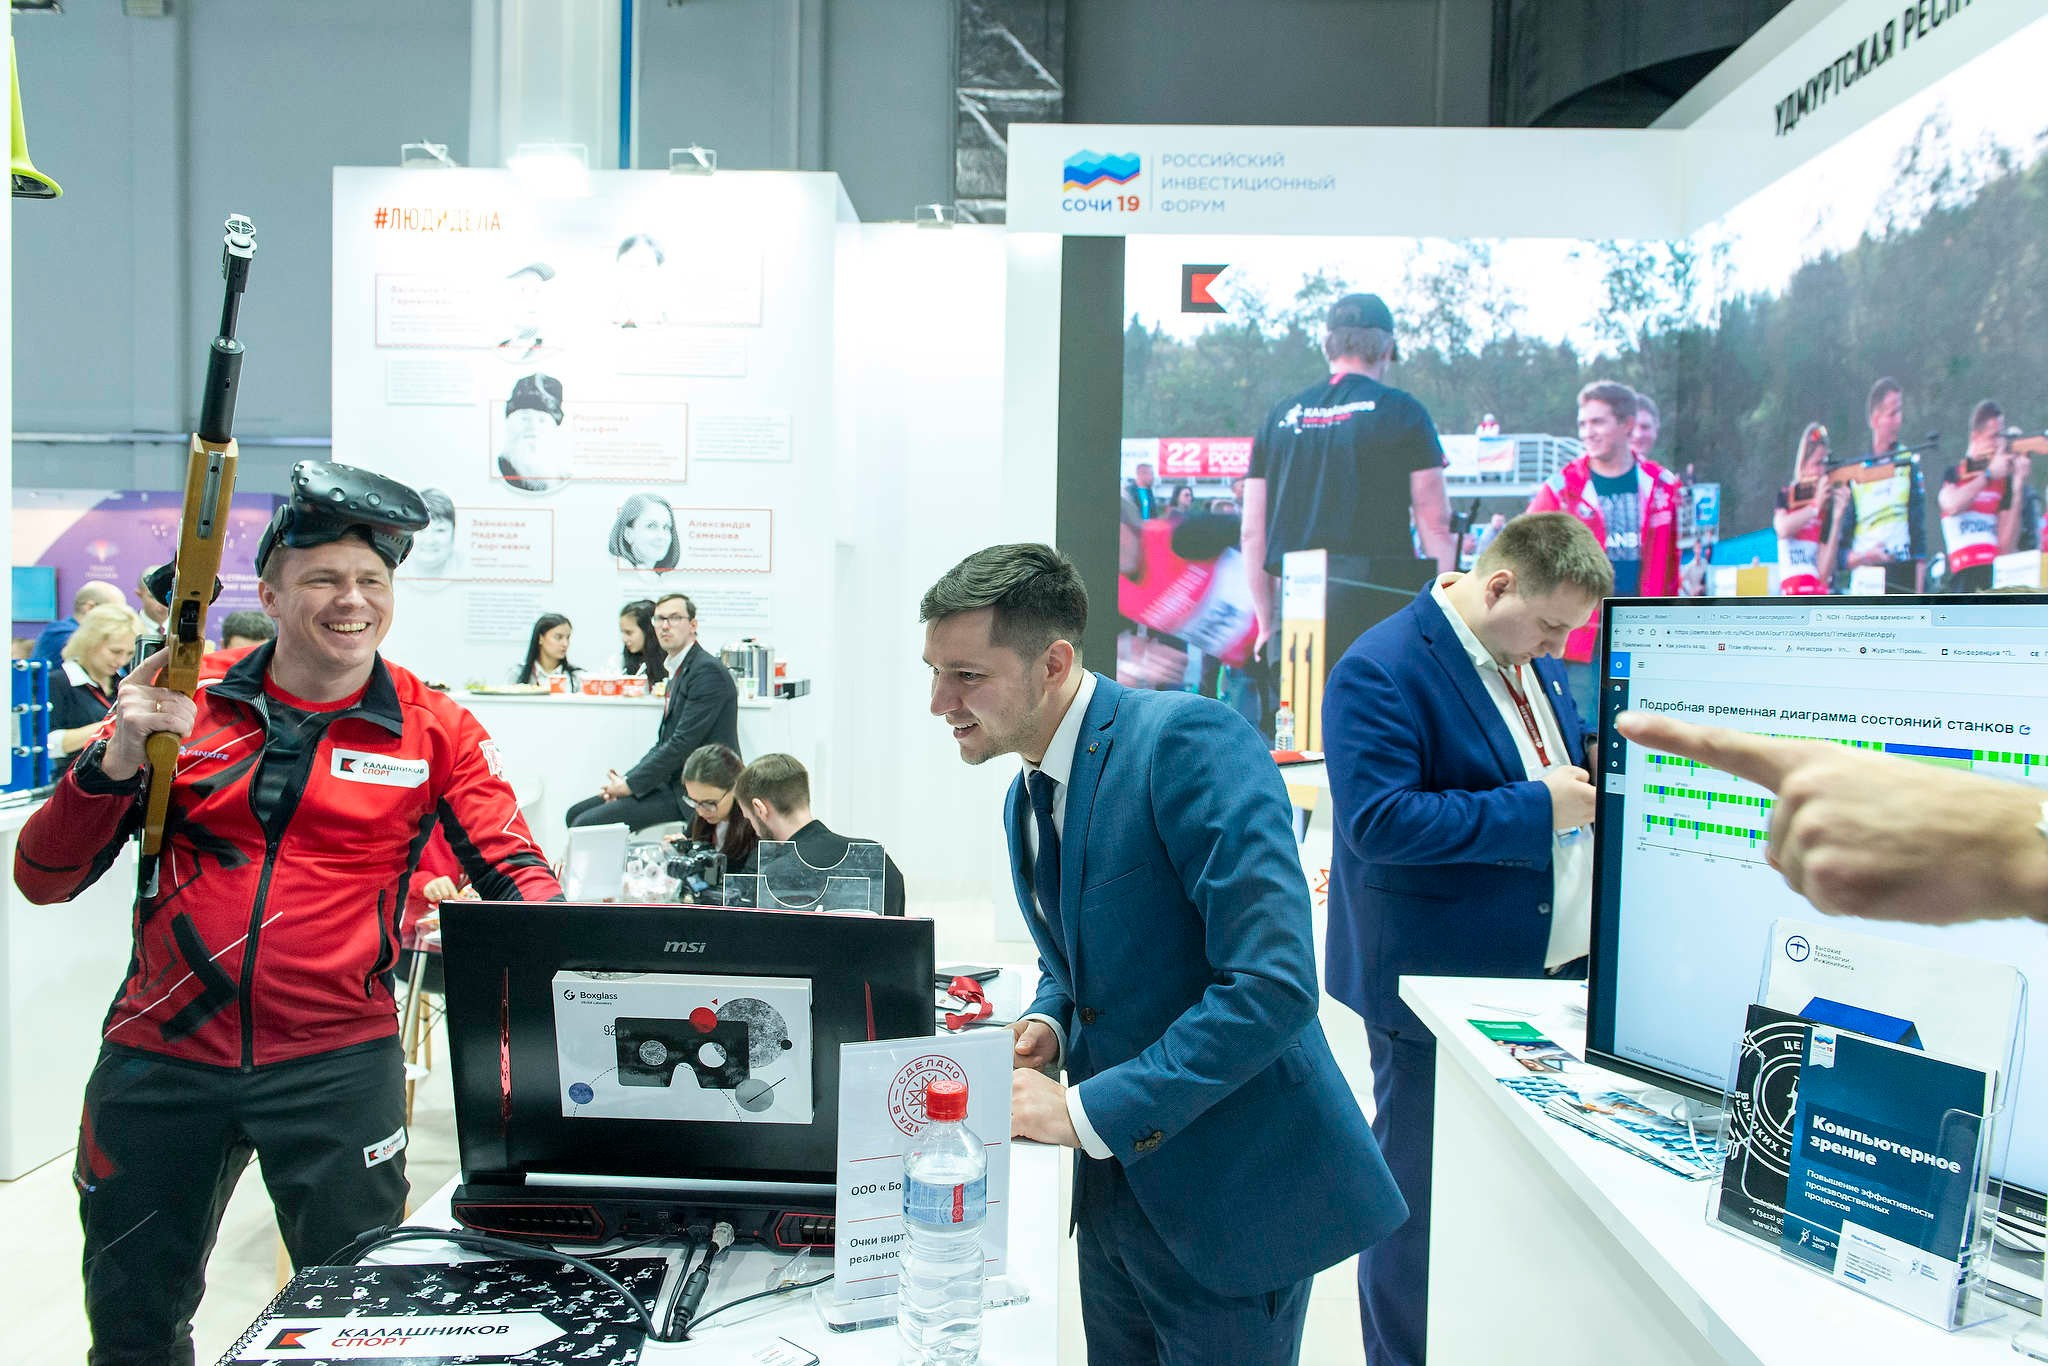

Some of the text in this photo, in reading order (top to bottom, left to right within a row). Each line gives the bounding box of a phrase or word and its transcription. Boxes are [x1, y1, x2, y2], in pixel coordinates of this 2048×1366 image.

[1774, 18, 1896, 136] УДМУРТСКАЯ
[1161, 152, 1286, 168] РОССИЙСКИЙ
[1161, 175, 1337, 191] ИНВЕСТИЦИОННЫЙ
[1062, 195, 1141, 212] СОЧИ 19
[1161, 199, 1226, 214] ФОРУМ
[1167, 442, 1202, 466] 22
[1640, 698, 2014, 734] Подробная временная диаграмма состояний станков
[362, 767, 391, 776] СПОРТ
[363, 761, 425, 774] КАЛАШНИКОВ
[664, 941, 707, 953] msi
[580, 991, 619, 1000] Boxglass
[898, 1059, 961, 1085] СДЕЛАНО
[1809, 1135, 1878, 1166] зрение
[1812, 1114, 1961, 1174] Компьютерное
[851, 1184, 877, 1196] ООО
[1805, 1180, 1890, 1216] производственных
[1806, 1169, 1935, 1220] Повышение эффективности
[1804, 1190, 1851, 1213] процессов
[850, 1236, 878, 1248] Очки
[1812, 1234, 1830, 1247] Центр
[337, 1325, 510, 1338] КАЛАШНИКОВ
[331, 1337, 412, 1347] СПОРТ
